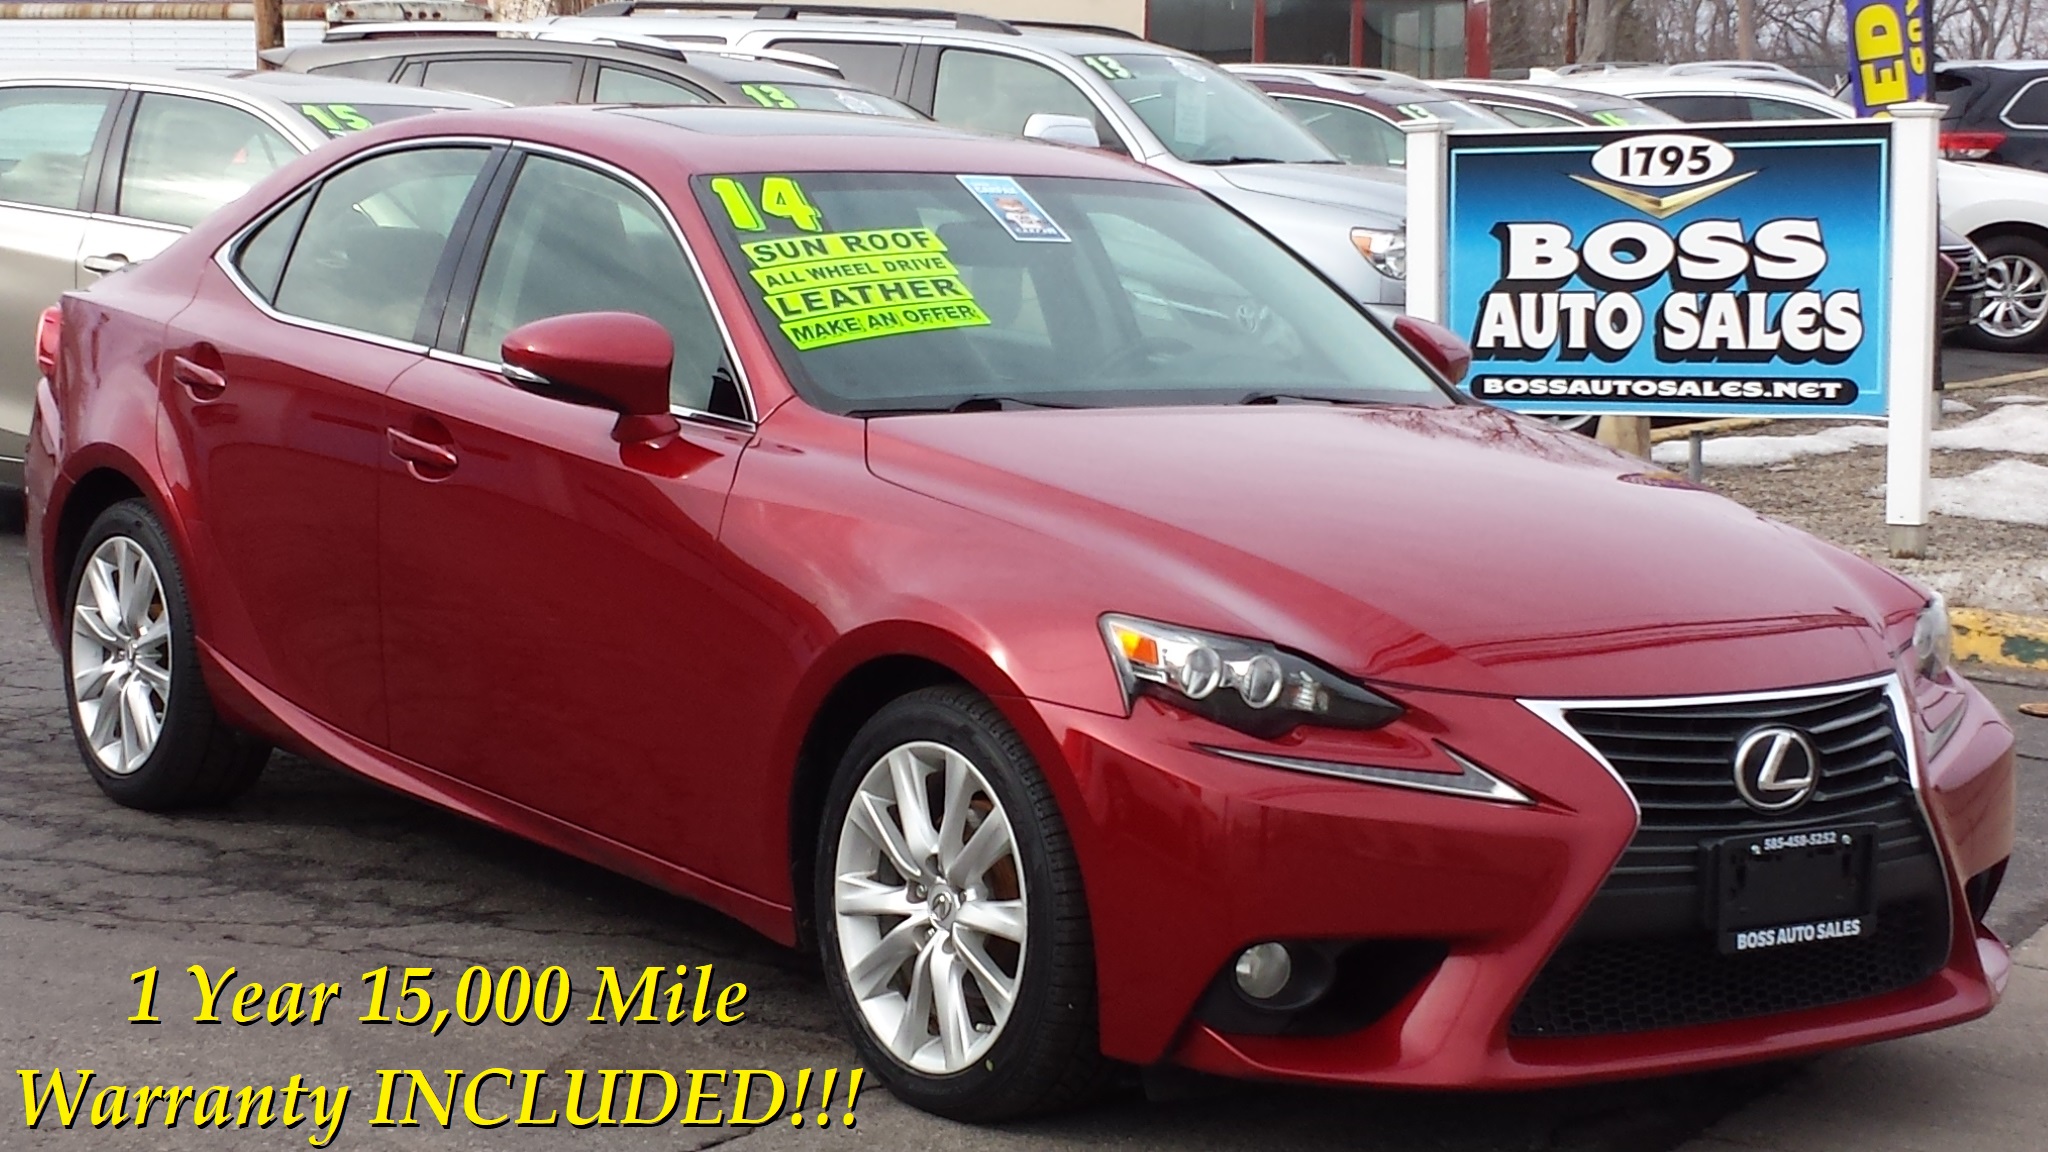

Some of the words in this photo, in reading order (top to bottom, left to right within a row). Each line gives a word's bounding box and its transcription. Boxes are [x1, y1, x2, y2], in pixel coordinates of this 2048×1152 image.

[1854, 3, 1908, 118] ED
[301, 104, 371, 130] 15
[1618, 144, 1712, 177] 1795
[711, 177, 823, 231] 14
[752, 237, 829, 262] SUN
[840, 231, 931, 253] ROOF
[1505, 218, 1828, 282] BOSS
[766, 271, 805, 289] ALL
[809, 263, 878, 282] WHEEL
[881, 257, 947, 273] DRIVE
[776, 278, 966, 317] LEATHER
[789, 317, 863, 343] MAKE
[866, 312, 899, 330] AN
[1477, 292, 1643, 351] AUTO
[1663, 290, 1863, 353] SALES
[1483, 378, 1842, 400] BOSSAUTOSALES.NET
[1736, 930, 1776, 950] BOSS
[1776, 923, 1815, 945] AUTO
[1816, 919, 1862, 940] SALES
